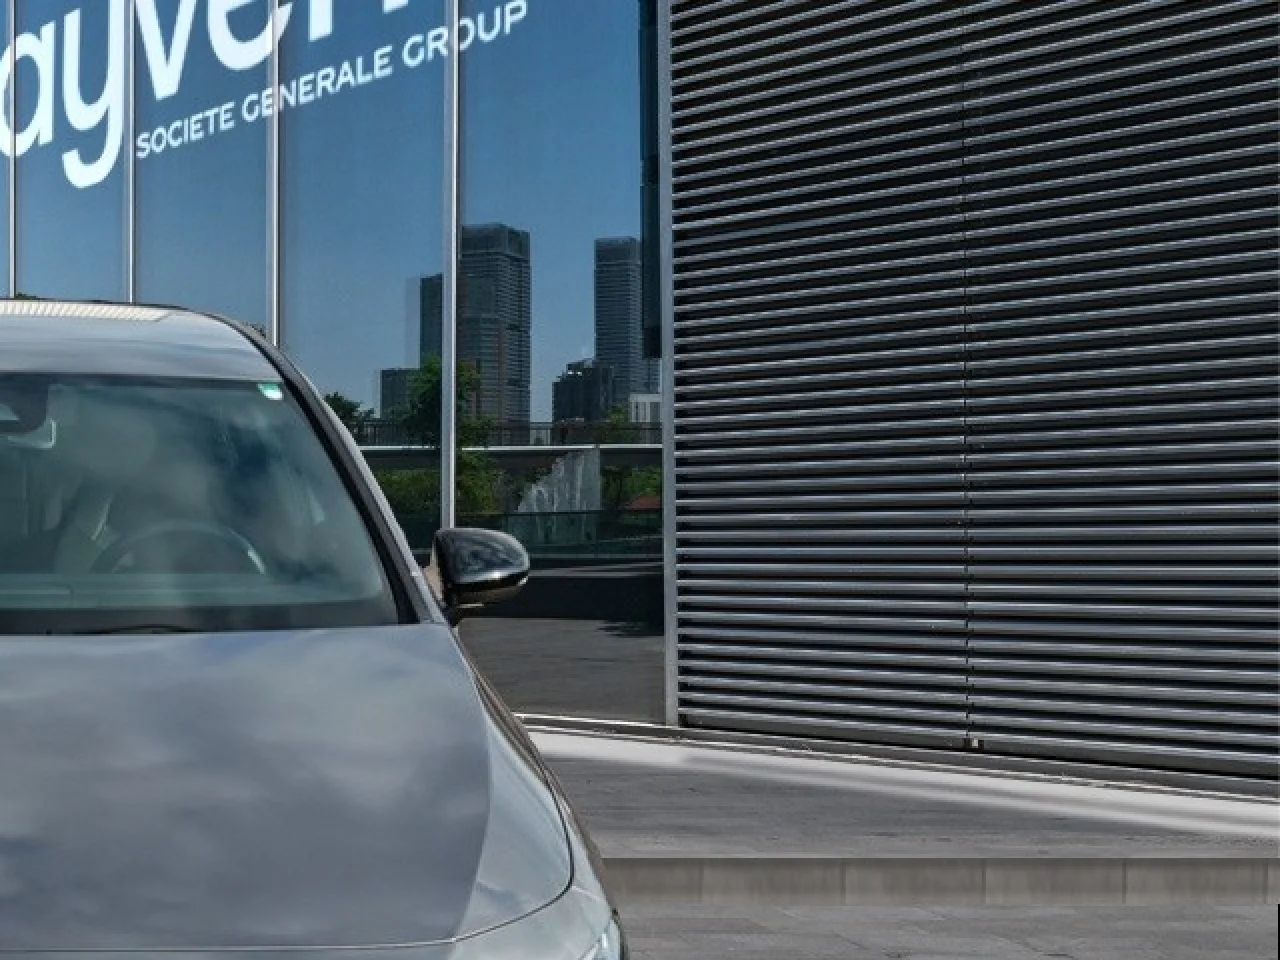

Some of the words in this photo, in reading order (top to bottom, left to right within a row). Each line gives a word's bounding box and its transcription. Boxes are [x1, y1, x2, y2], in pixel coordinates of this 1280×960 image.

[136, 101, 235, 159] SOCIETE
[241, 46, 393, 123] GENERALE
[402, 0, 527, 68] GROUP
